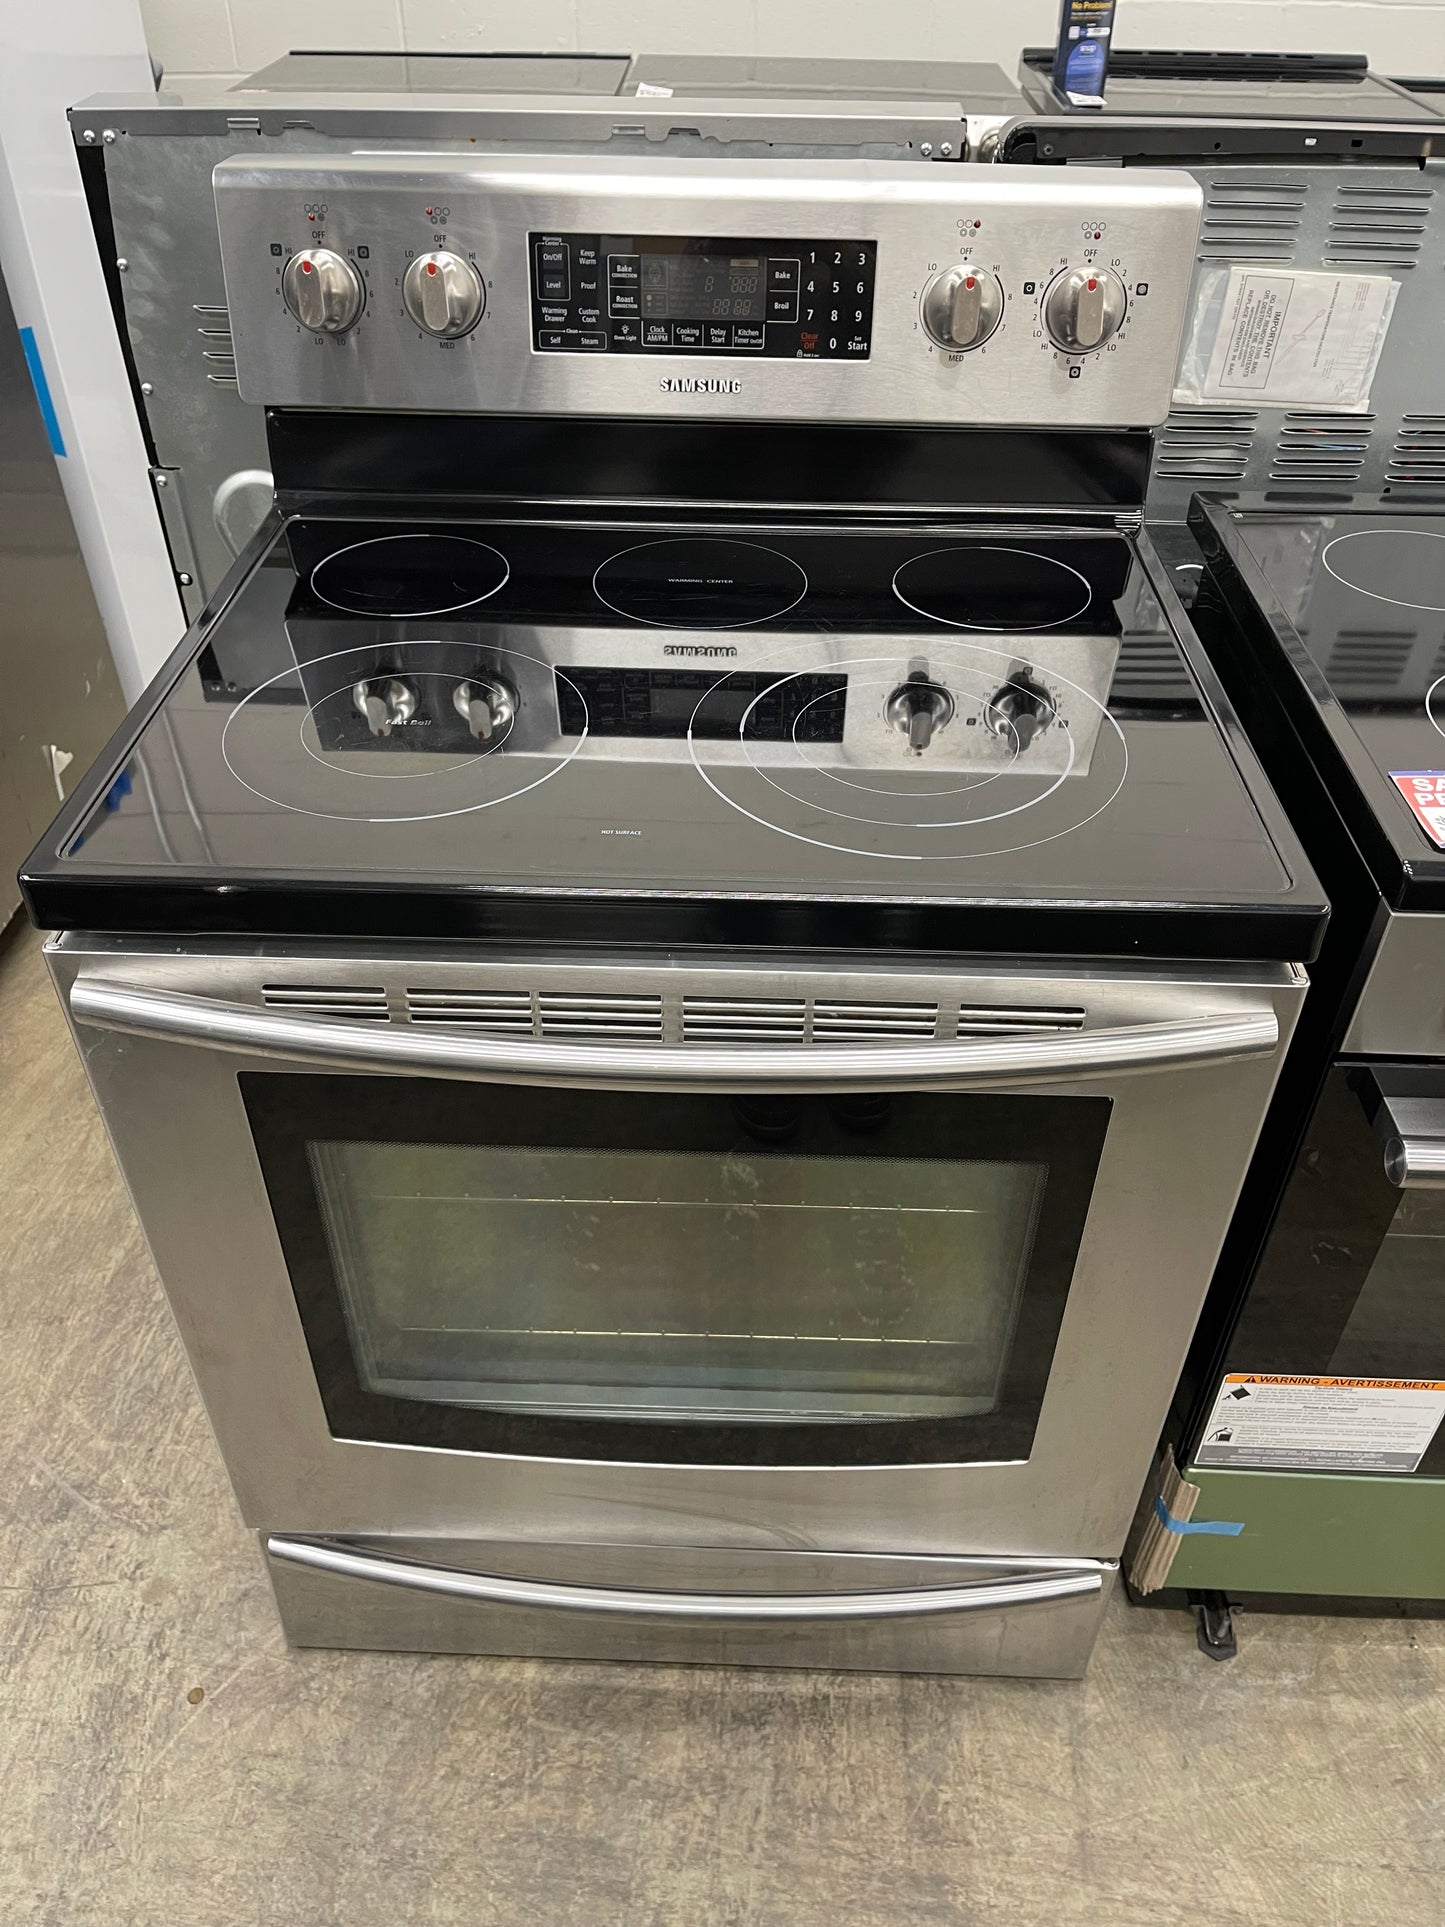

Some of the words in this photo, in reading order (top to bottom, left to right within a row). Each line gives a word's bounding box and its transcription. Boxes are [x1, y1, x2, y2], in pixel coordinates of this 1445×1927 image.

[312, 231, 326, 239] OFF
[405, 250, 414, 258] LO
[468, 252, 476, 260] HI
[543, 253, 563, 261] On/Off
[580, 249, 595, 258] Keep
[1084, 249, 1098, 257] OFF
[810, 252, 816, 264] 1
[834, 252, 841, 264] 2
[858, 253, 866, 265] 3
[1111, 258, 1121, 266] LO
[928, 263, 937, 271] LO
[992, 264, 1000, 272] HI
[581, 282, 596, 290] Proof
[807, 281, 815, 292] 4
[833, 282, 840, 293] 5
[857, 282, 864, 294] 6
[1263, 289, 1271, 299] OR
[1269, 294, 1276, 303] DO
[774, 302, 789, 310] Broil
[1242, 289, 1254, 318] REPLACE
[542, 307, 568, 316] Warming
[807, 309, 814, 321] 7
[831, 310, 838, 321] 8
[855, 310, 862, 322] 9
[1256, 301, 1268, 329] DESTROY
[1265, 305, 1273, 318] NOT
[676, 327, 700, 336] Cooking
[710, 328, 726, 336] Delay
[801, 332, 819, 340] Clear
[1033, 330, 1042, 338] LO
[1118, 332, 1126, 340] HI
[1233, 320, 1246, 352] CONTENTS
[1258, 320, 1269, 344] REMOVE
[1263, 311, 1281, 359] IMPORTANT
[581, 337, 599, 345] Steam
[647, 334, 668, 342] AM/PM
[440, 342, 455, 350] MED
[804, 342, 815, 350] Off
[830, 338, 837, 350] 0
[848, 341, 867, 350] Start
[1107, 343, 1117, 351] LO
[1254, 346, 1262, 359] THIS
[948, 354, 965, 362] MED
[1242, 345, 1256, 377] CONTENTS
[1250, 361, 1258, 374] BAG
[660, 377, 742, 394] SAMSUNG
[1260, 1376, 1320, 1385] WARNING
[1331, 1379, 1439, 1389] AVERTISSEMENT
